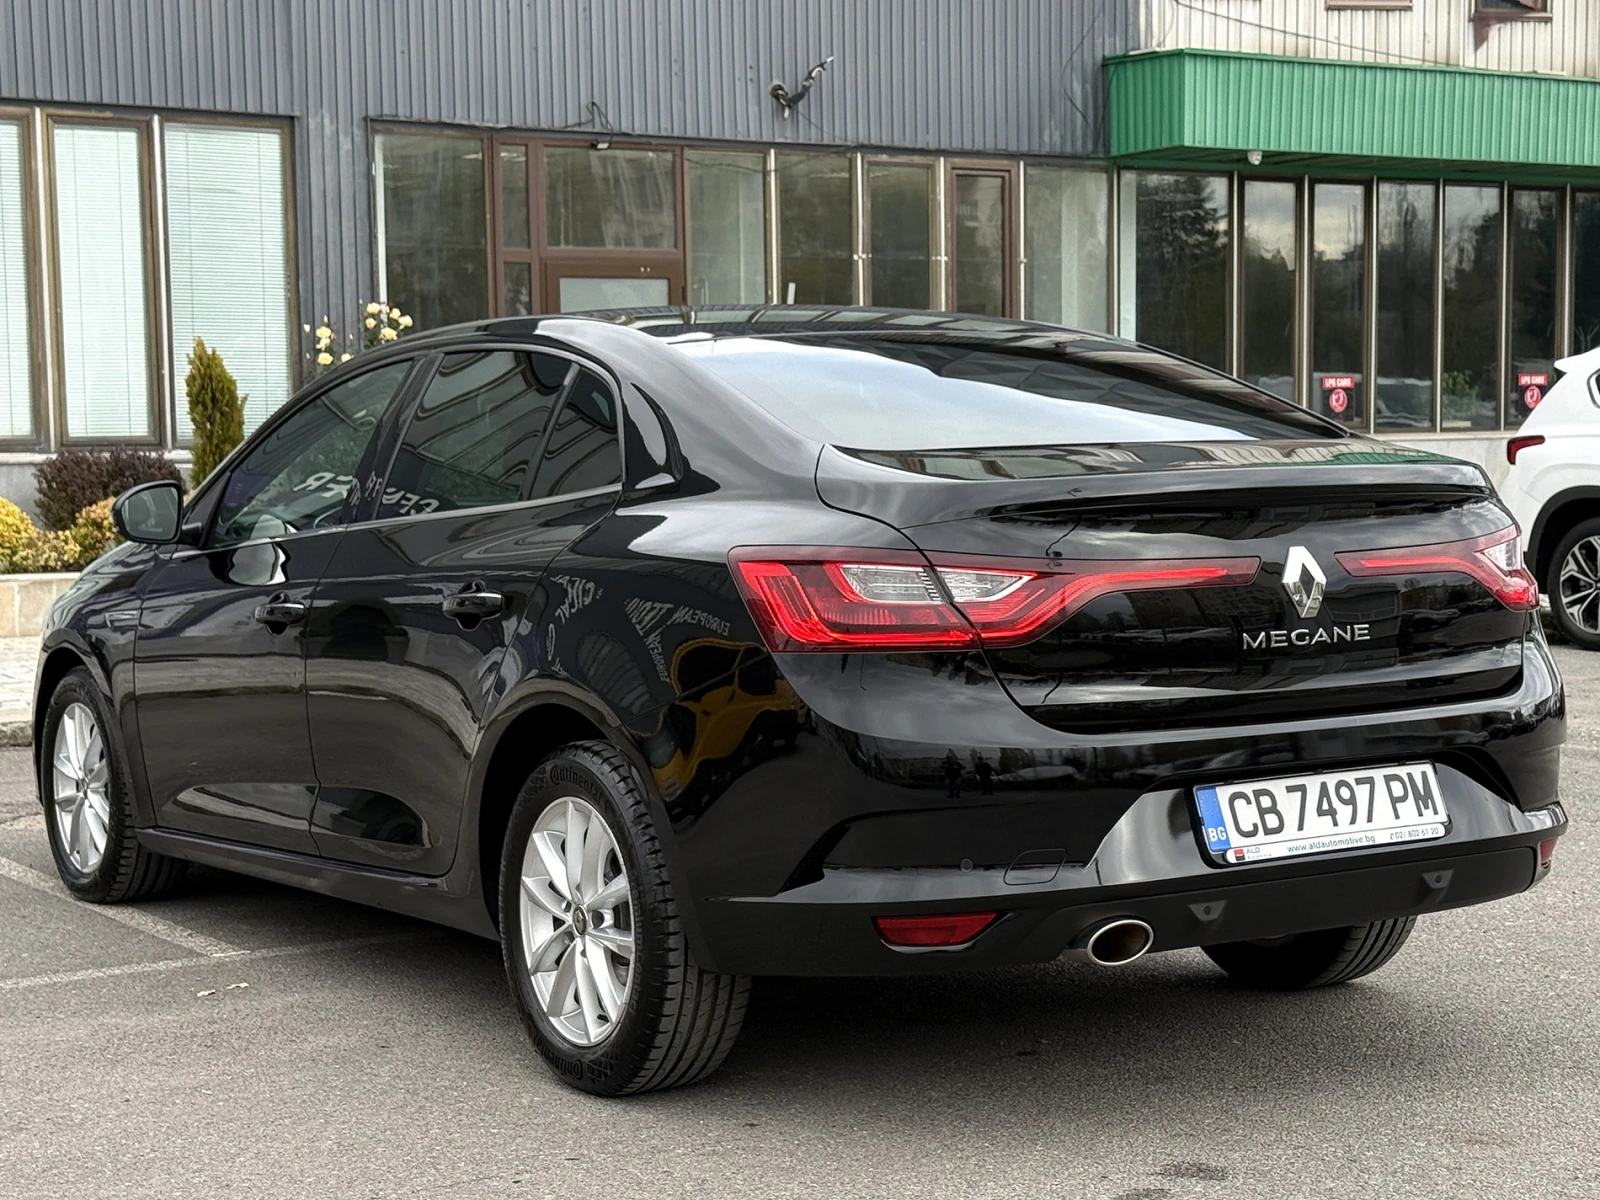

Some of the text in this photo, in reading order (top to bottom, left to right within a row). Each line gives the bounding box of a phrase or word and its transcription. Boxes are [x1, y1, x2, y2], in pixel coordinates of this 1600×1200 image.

[1242, 624, 1371, 650] MEGANE
[550, 764, 603, 804] Continental
[1228, 770, 1439, 838] CB 7497 PM
[1208, 825, 1227, 843] BG
[1286, 834, 1376, 853] www.aldautomotive.bg
[1431, 826, 1440, 836] 20
[1246, 846, 1261, 854] ALD
